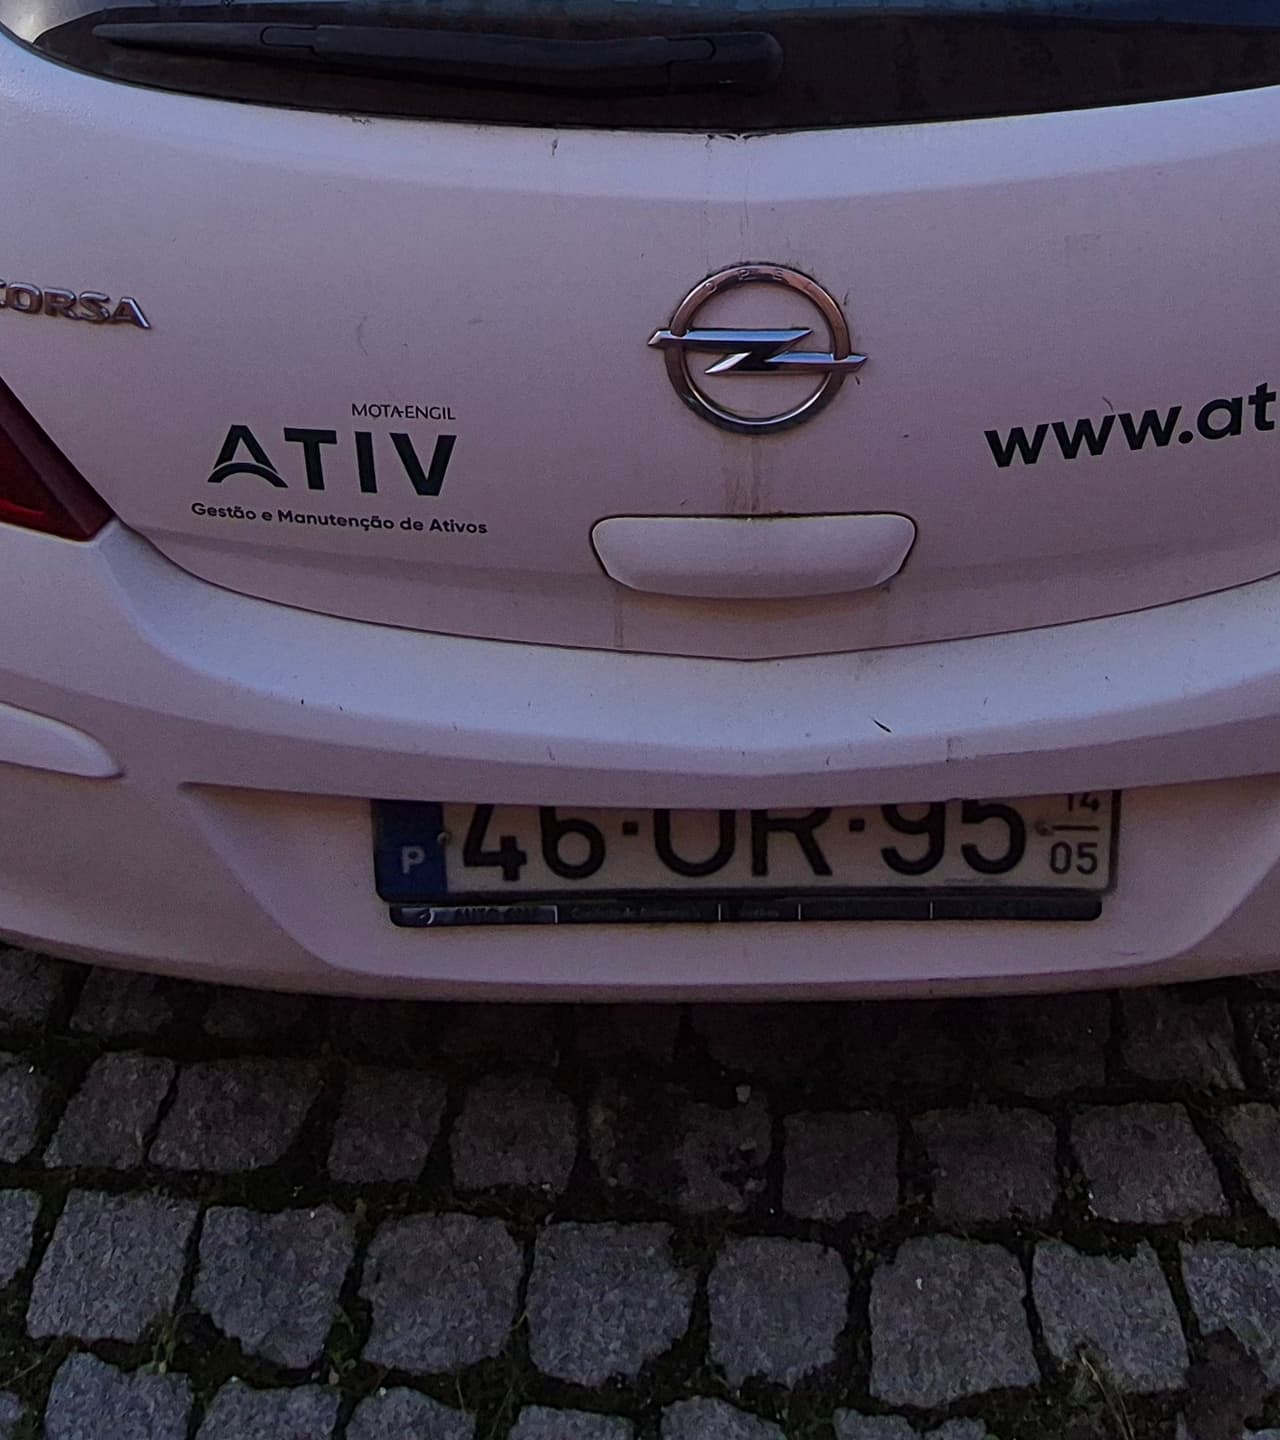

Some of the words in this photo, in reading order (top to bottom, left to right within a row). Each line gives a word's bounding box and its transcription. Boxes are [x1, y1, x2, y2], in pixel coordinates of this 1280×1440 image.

[351, 402, 457, 421] MOTA-ENGIL
[207, 424, 458, 498] ATIV
[191, 502, 257, 521] Gestão
[261, 510, 273, 522] e
[278, 510, 395, 531] Manutenção
[400, 516, 424, 531] de
[429, 518, 488, 534] Ativos
[401, 845, 426, 875] P
[1050, 841, 1099, 876] 05
